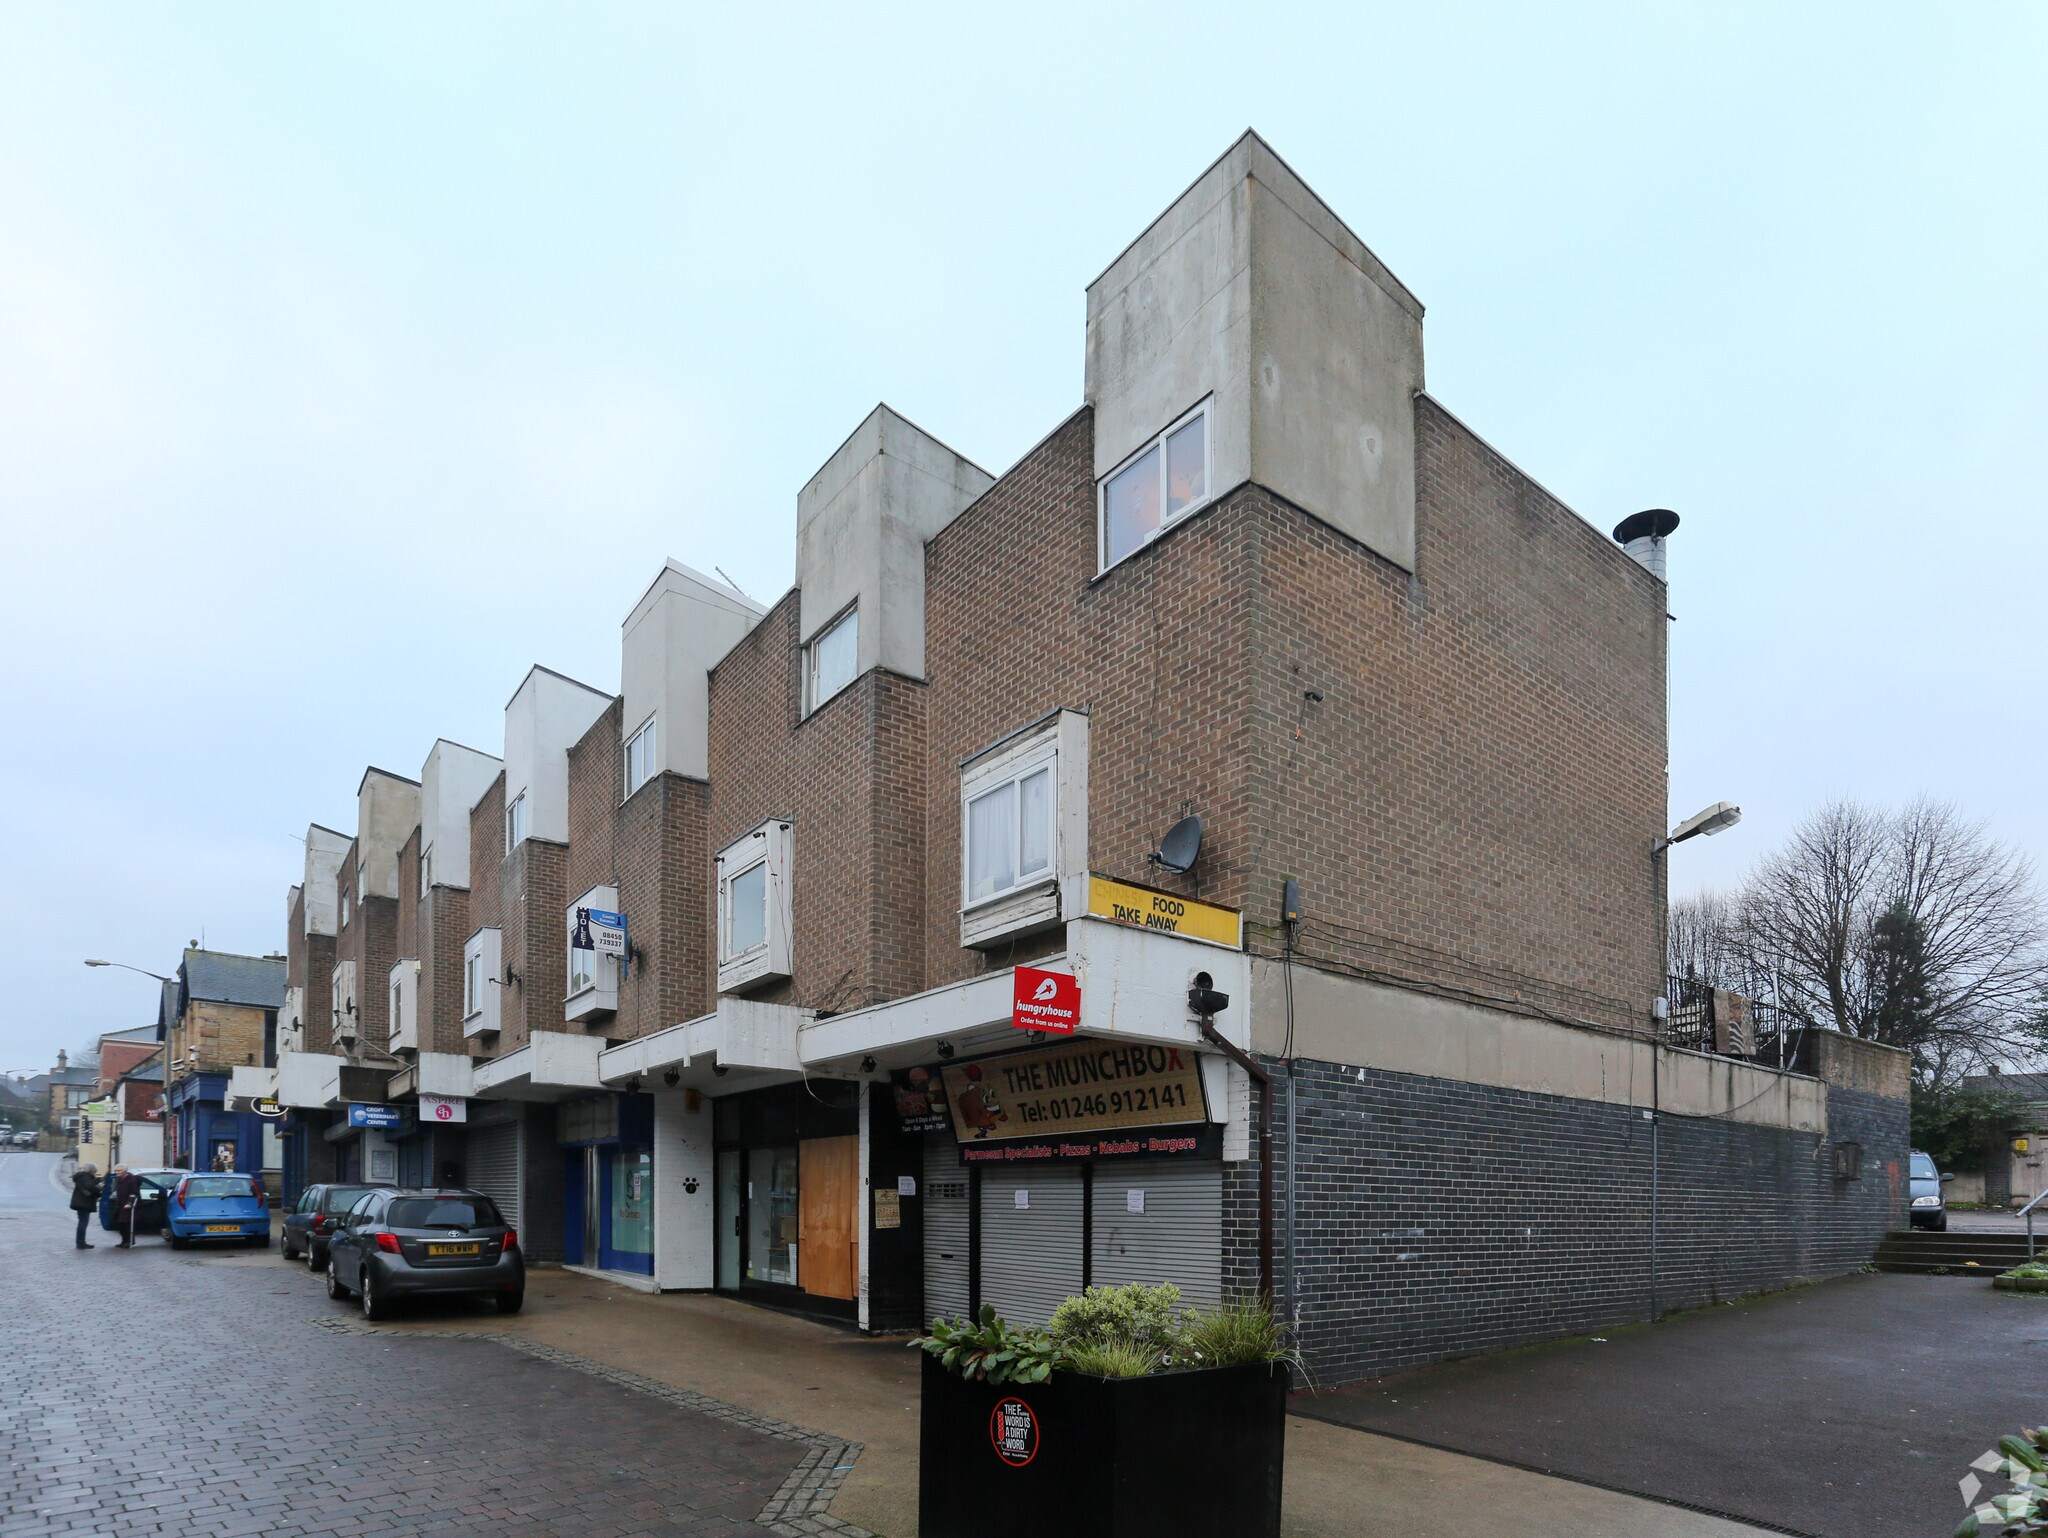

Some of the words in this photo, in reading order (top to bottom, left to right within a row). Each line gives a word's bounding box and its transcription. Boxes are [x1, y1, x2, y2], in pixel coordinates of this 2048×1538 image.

[1153, 896, 1185, 917] FOOD
[580, 912, 587, 925] TO
[1112, 904, 1141, 925] TAKE
[1145, 912, 1178, 932] AWAY
[1016, 999, 1072, 1018] hungryhouse
[1020, 1016, 1034, 1024] Order
[1035, 1018, 1047, 1026] from
[1053, 1021, 1068, 1029] online
[1003, 1063, 1044, 1094] THE
[1046, 1046, 1184, 1088] MUNCHBOX
[423, 1096, 463, 1105] ASPIRE
[1017, 1101, 1048, 1123] Tel:
[1050, 1094, 1107, 1120] 01246
[1110, 1083, 1186, 1114] 912141
[260, 1104, 280, 1112] HILL
[1004, 1145, 1052, 1160] Specialists
[1059, 1144, 1091, 1157] Pizzas
[1099, 1139, 1140, 1155] Kebabs
[1149, 1137, 1196, 1153] Burgers
[434, 1244, 454, 1253] YT16
[1004, 1404, 1017, 1415] THE
[1004, 1416, 1023, 1427] WORD
[1024, 1416, 1031, 1428] IS
[1005, 1427, 1010, 1437] A
[1010, 1428, 1028, 1439] DIRTY
[1006, 1438, 1024, 1450] WORD
